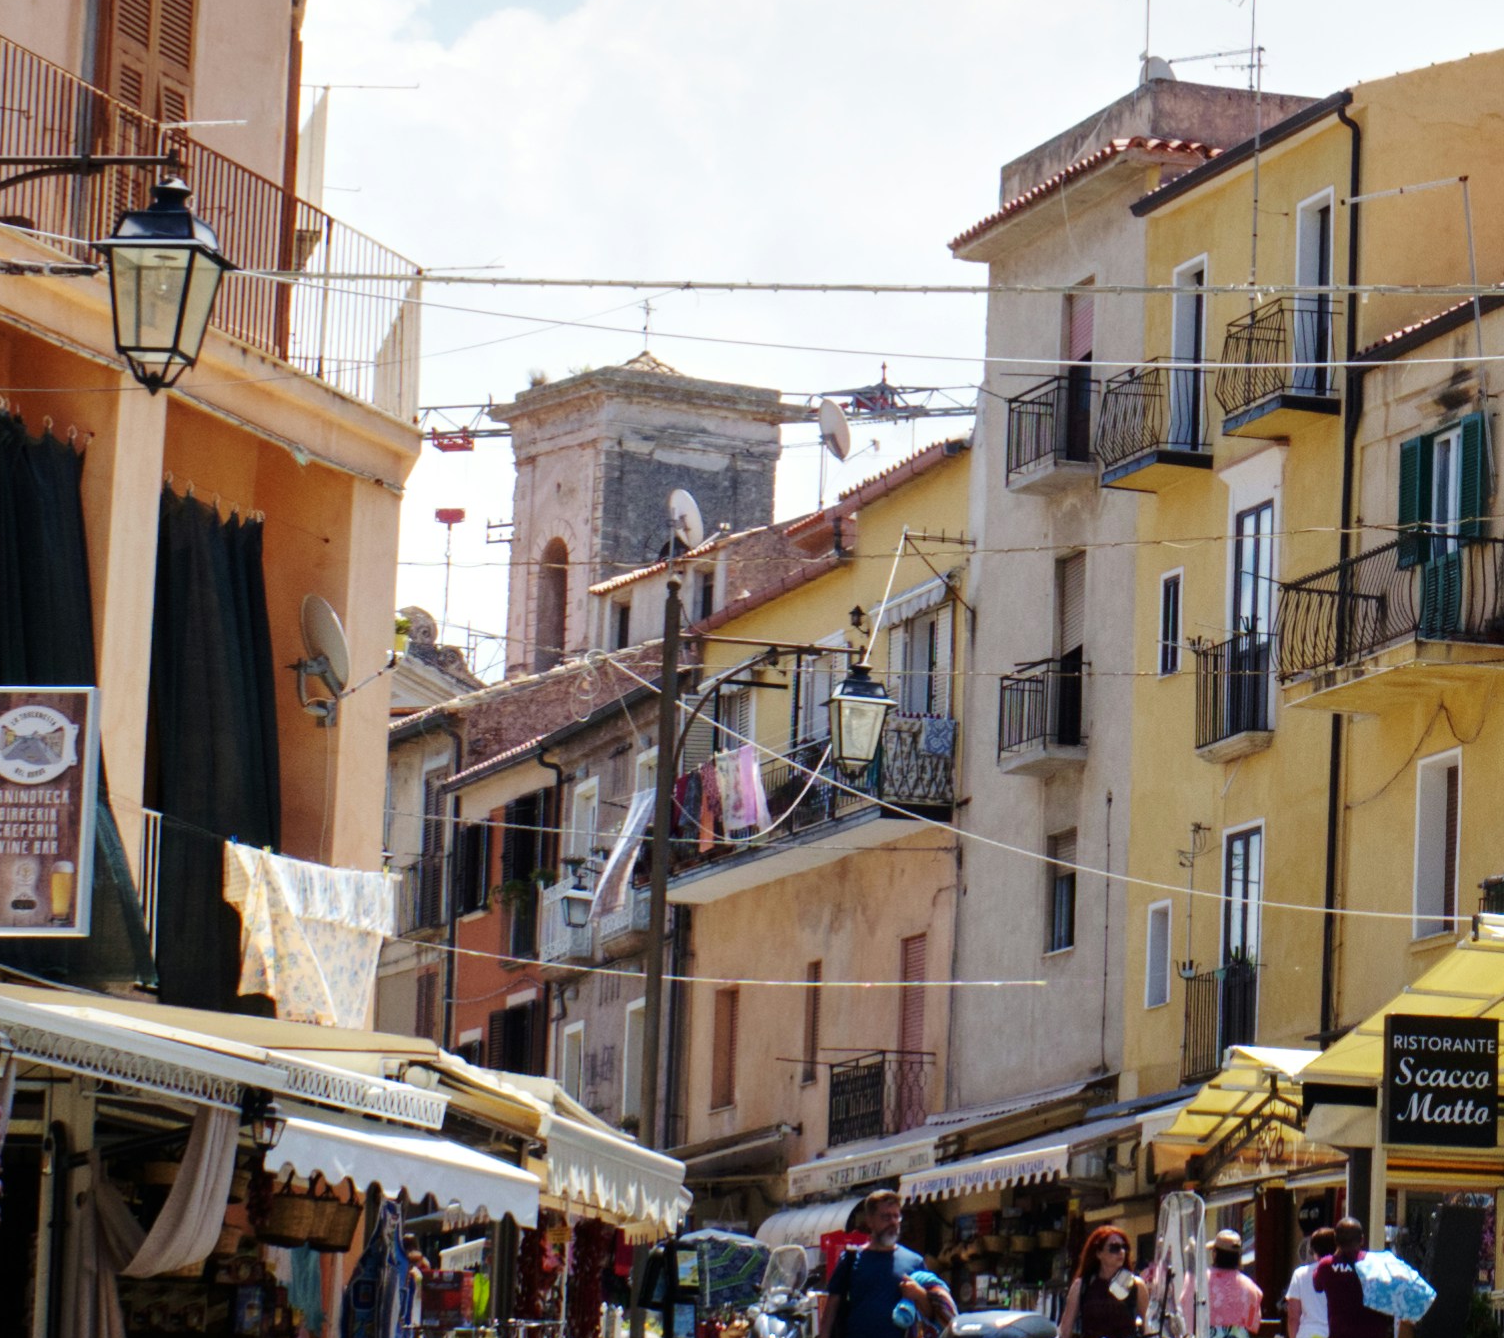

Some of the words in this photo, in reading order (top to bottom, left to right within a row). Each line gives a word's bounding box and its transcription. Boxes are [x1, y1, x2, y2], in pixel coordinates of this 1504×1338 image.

[33, 841, 58, 855] BAR
[1394, 1034, 1496, 1054] RISTORANTE
[1395, 1056, 1492, 1090] Scacco
[1396, 1092, 1492, 1125] Matto
